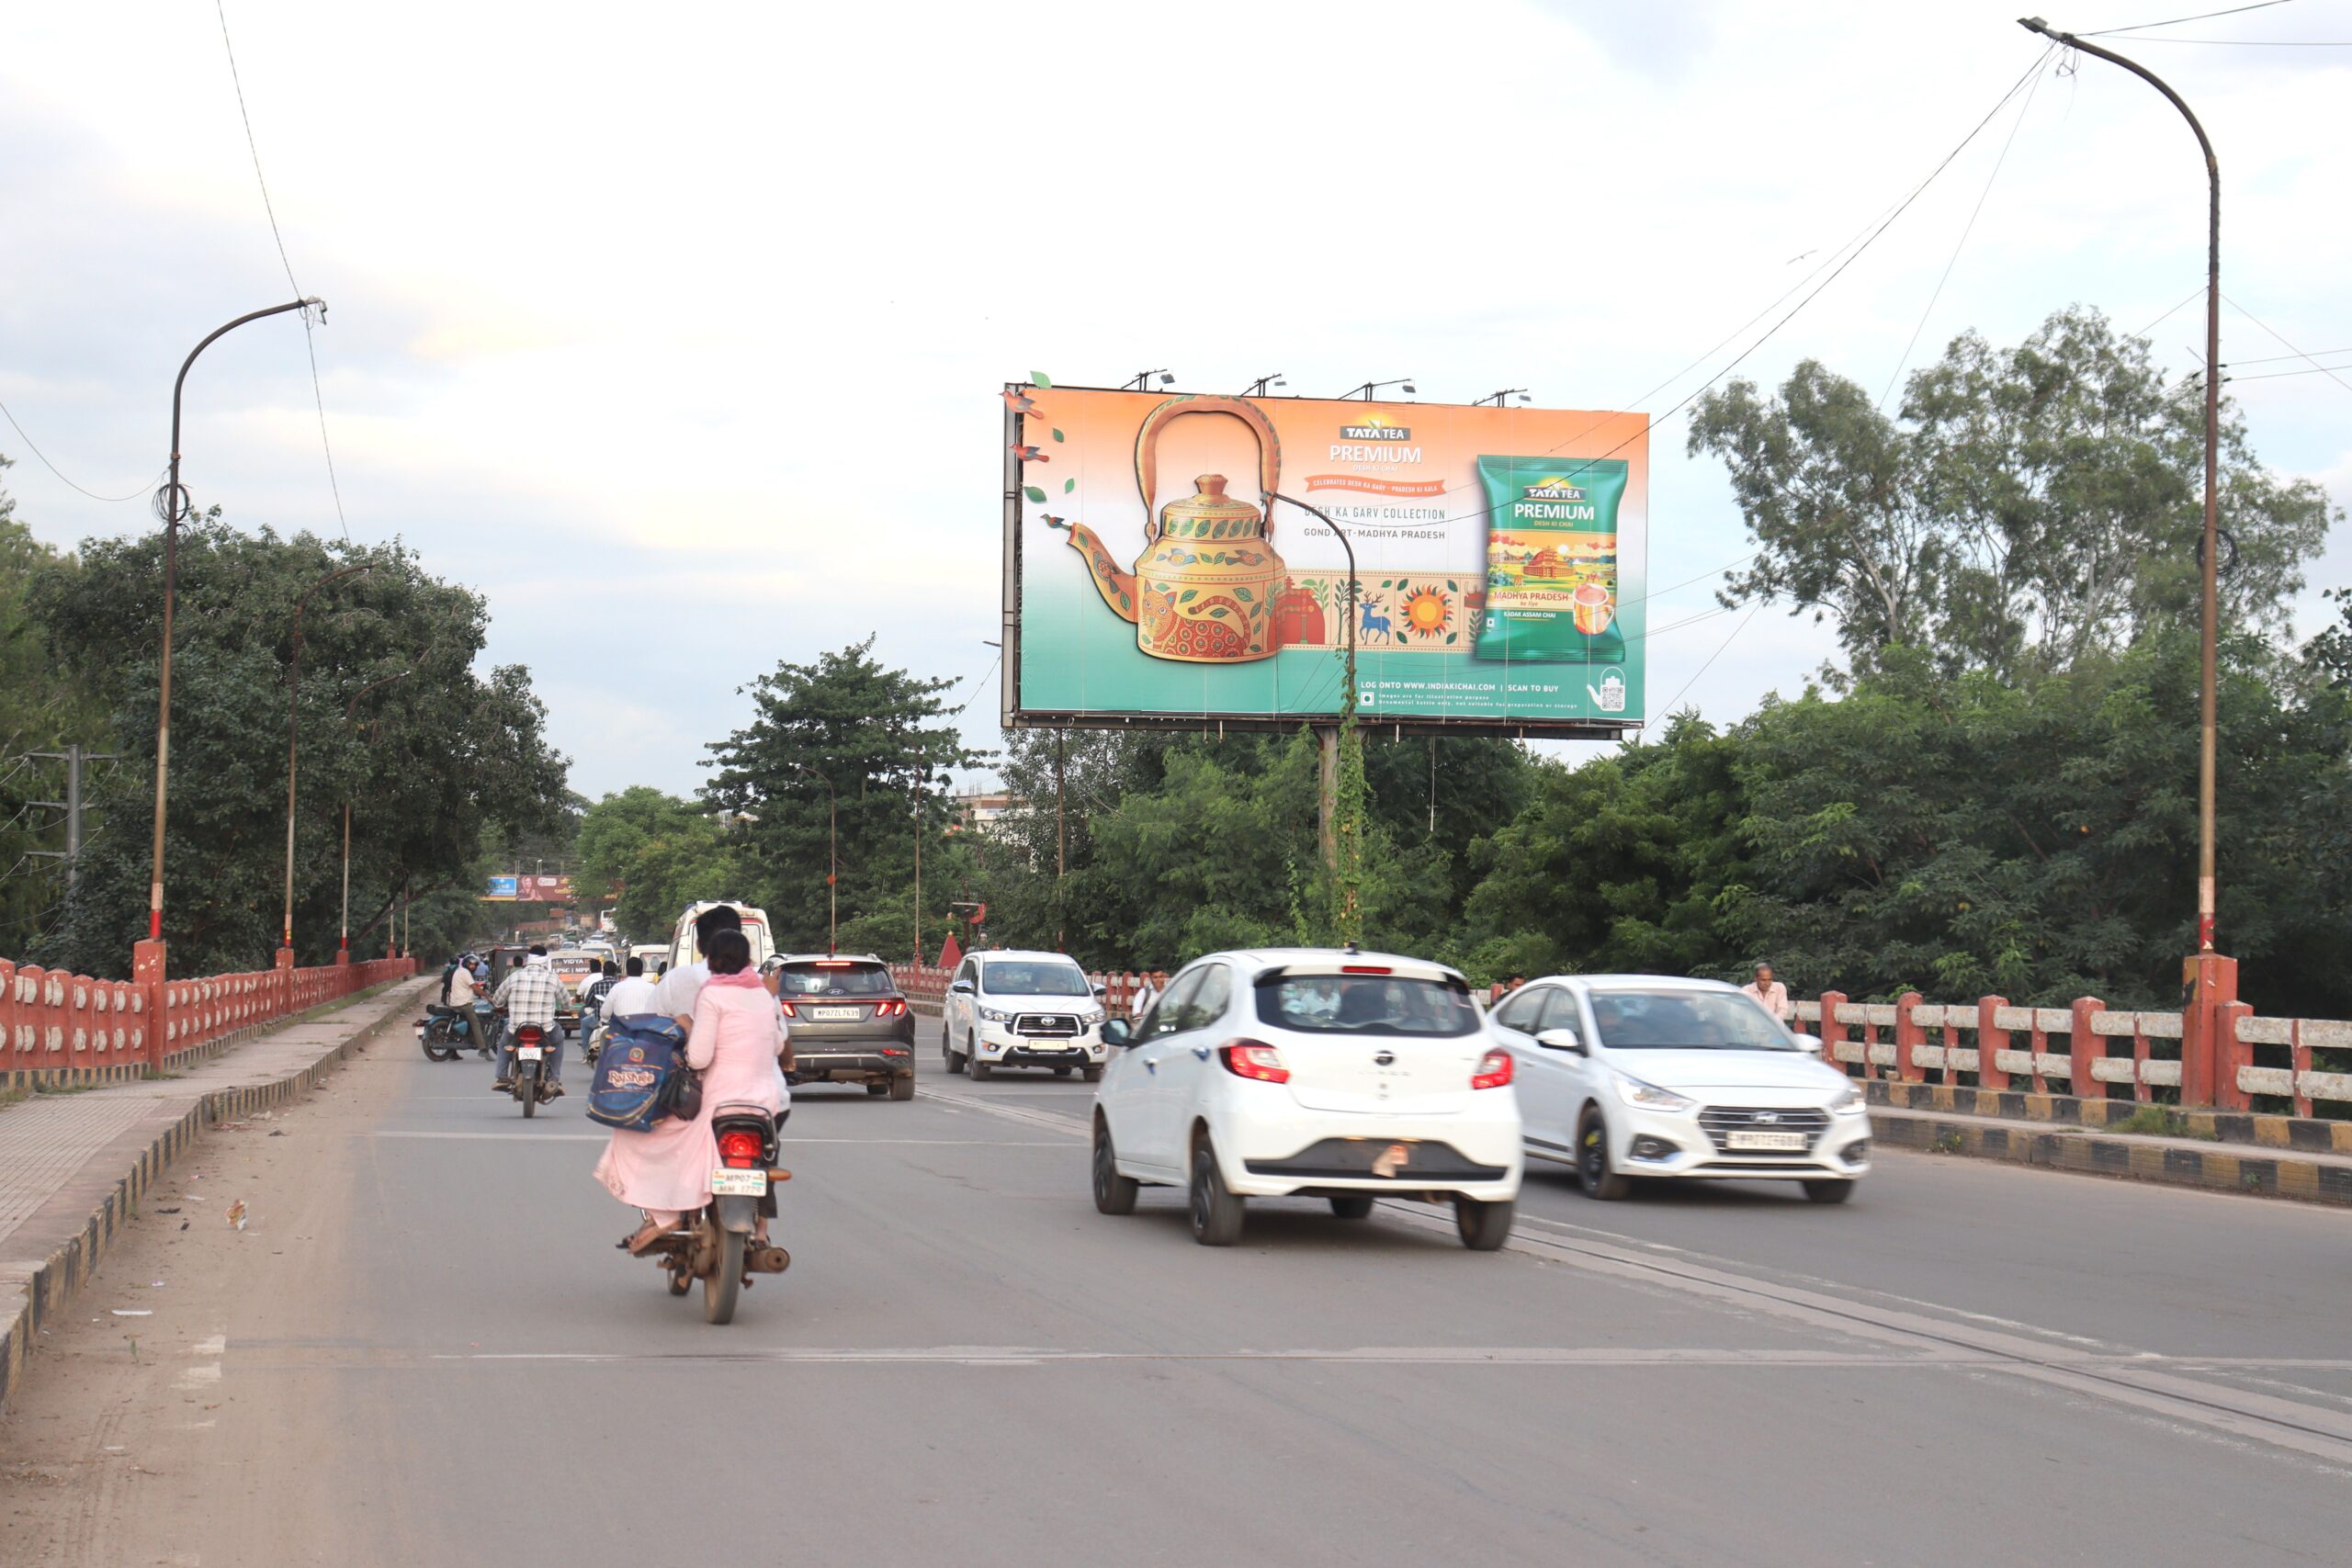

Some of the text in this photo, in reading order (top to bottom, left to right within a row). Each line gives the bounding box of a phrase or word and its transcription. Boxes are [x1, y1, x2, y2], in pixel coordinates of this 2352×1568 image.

[1347, 427, 1404, 439] TATA TEA
[1329, 445, 1422, 463] PREMIUM
[1313, 479, 1346, 487] CELEBRATES
[1392, 485, 1416, 493] PRADESH
[1529, 489, 1580, 499] TATA TEA
[1336, 507, 1348, 517] KA
[1353, 507, 1378, 518] GARV
[1384, 508, 1445, 520] COLLECTION
[1514, 503, 1595, 520] PREMIUM
[1304, 528, 1330, 536] GOND
[1401, 530, 1445, 539] PRADESH
[1494, 592, 1569, 601] MADHYA PRADESH
[1403, 682, 1496, 691] WWW.INDIAKICHAI.COM
